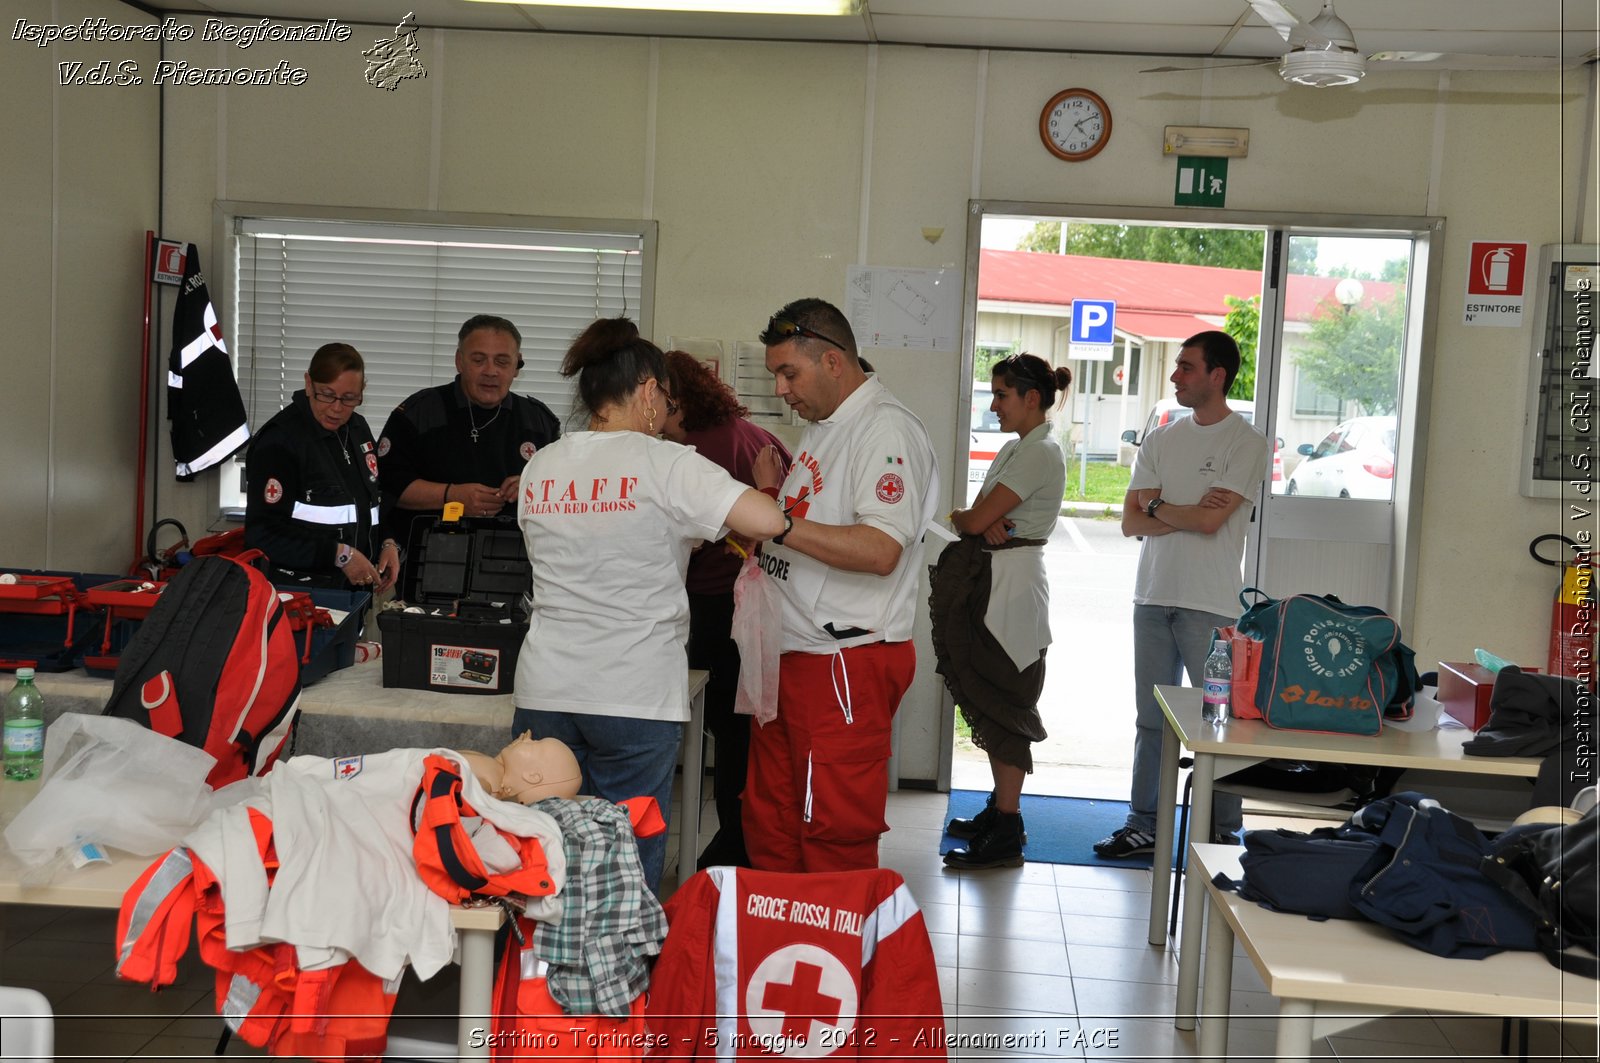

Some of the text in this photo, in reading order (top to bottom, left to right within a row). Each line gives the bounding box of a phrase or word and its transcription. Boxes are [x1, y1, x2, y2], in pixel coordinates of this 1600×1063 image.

[1072, 100, 1083, 108] 12
[1093, 122, 1100, 130] 3
[1466, 303, 1522, 314] ESTINTORE
[1080, 304, 1108, 339] P
[524, 477, 638, 504] STAFF
[563, 501, 588, 515] RED
[591, 499, 636, 513] CROSS
[746, 893, 864, 937] CROCE ROSSA ITALI
